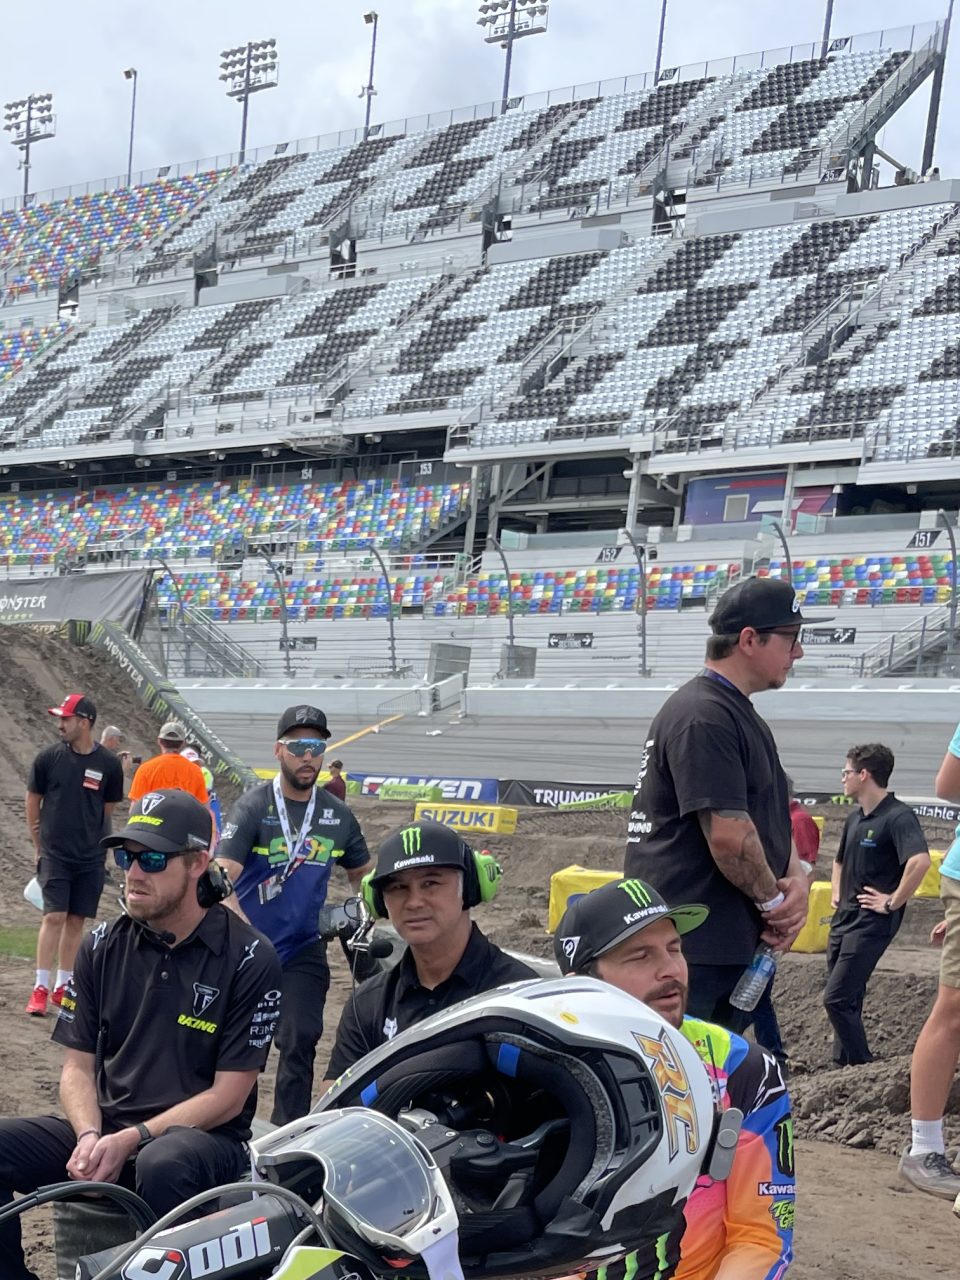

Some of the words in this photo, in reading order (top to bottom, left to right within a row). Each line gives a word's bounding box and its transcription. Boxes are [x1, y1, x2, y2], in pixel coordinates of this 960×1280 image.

[914, 533, 931, 546] 151
[601, 549, 617, 562] 152
[419, 808, 495, 828] SUZUKI
[394, 854, 435, 870] Kawasaki
